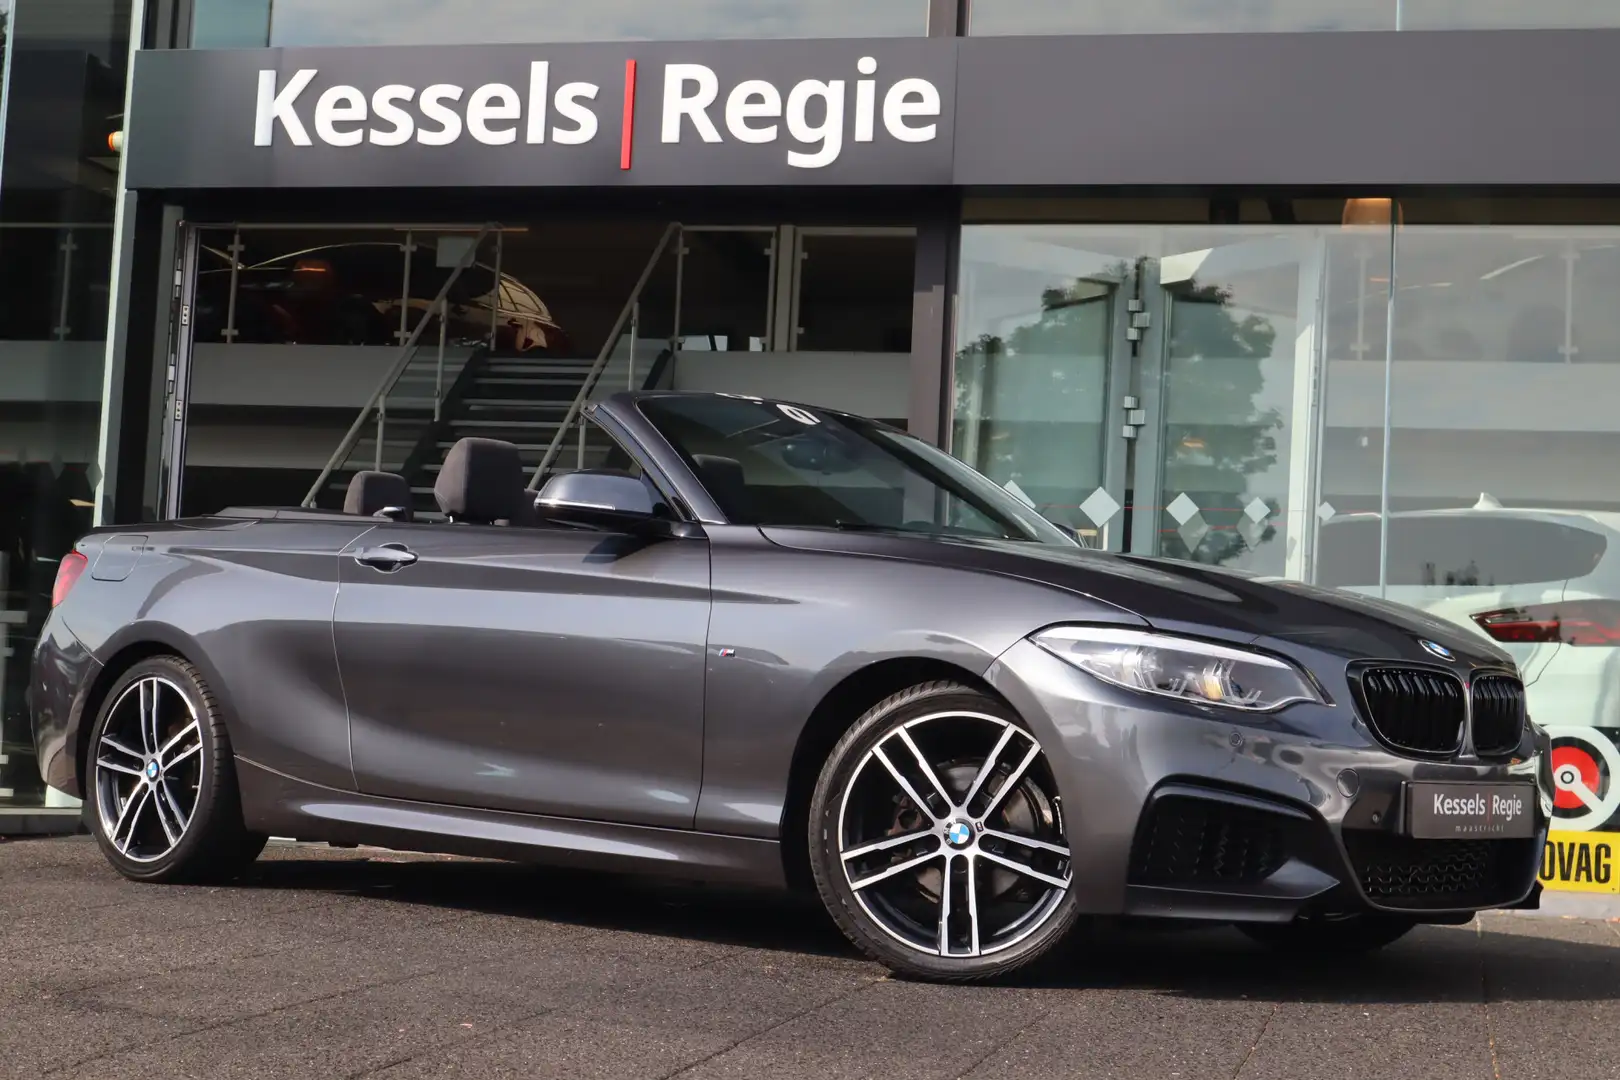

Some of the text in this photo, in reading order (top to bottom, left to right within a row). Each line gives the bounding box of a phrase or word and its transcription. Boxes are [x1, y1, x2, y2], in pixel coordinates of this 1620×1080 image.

[254, 56, 941, 168] Kessels Regie
[1433, 793, 1522, 821] Kessels Regie
